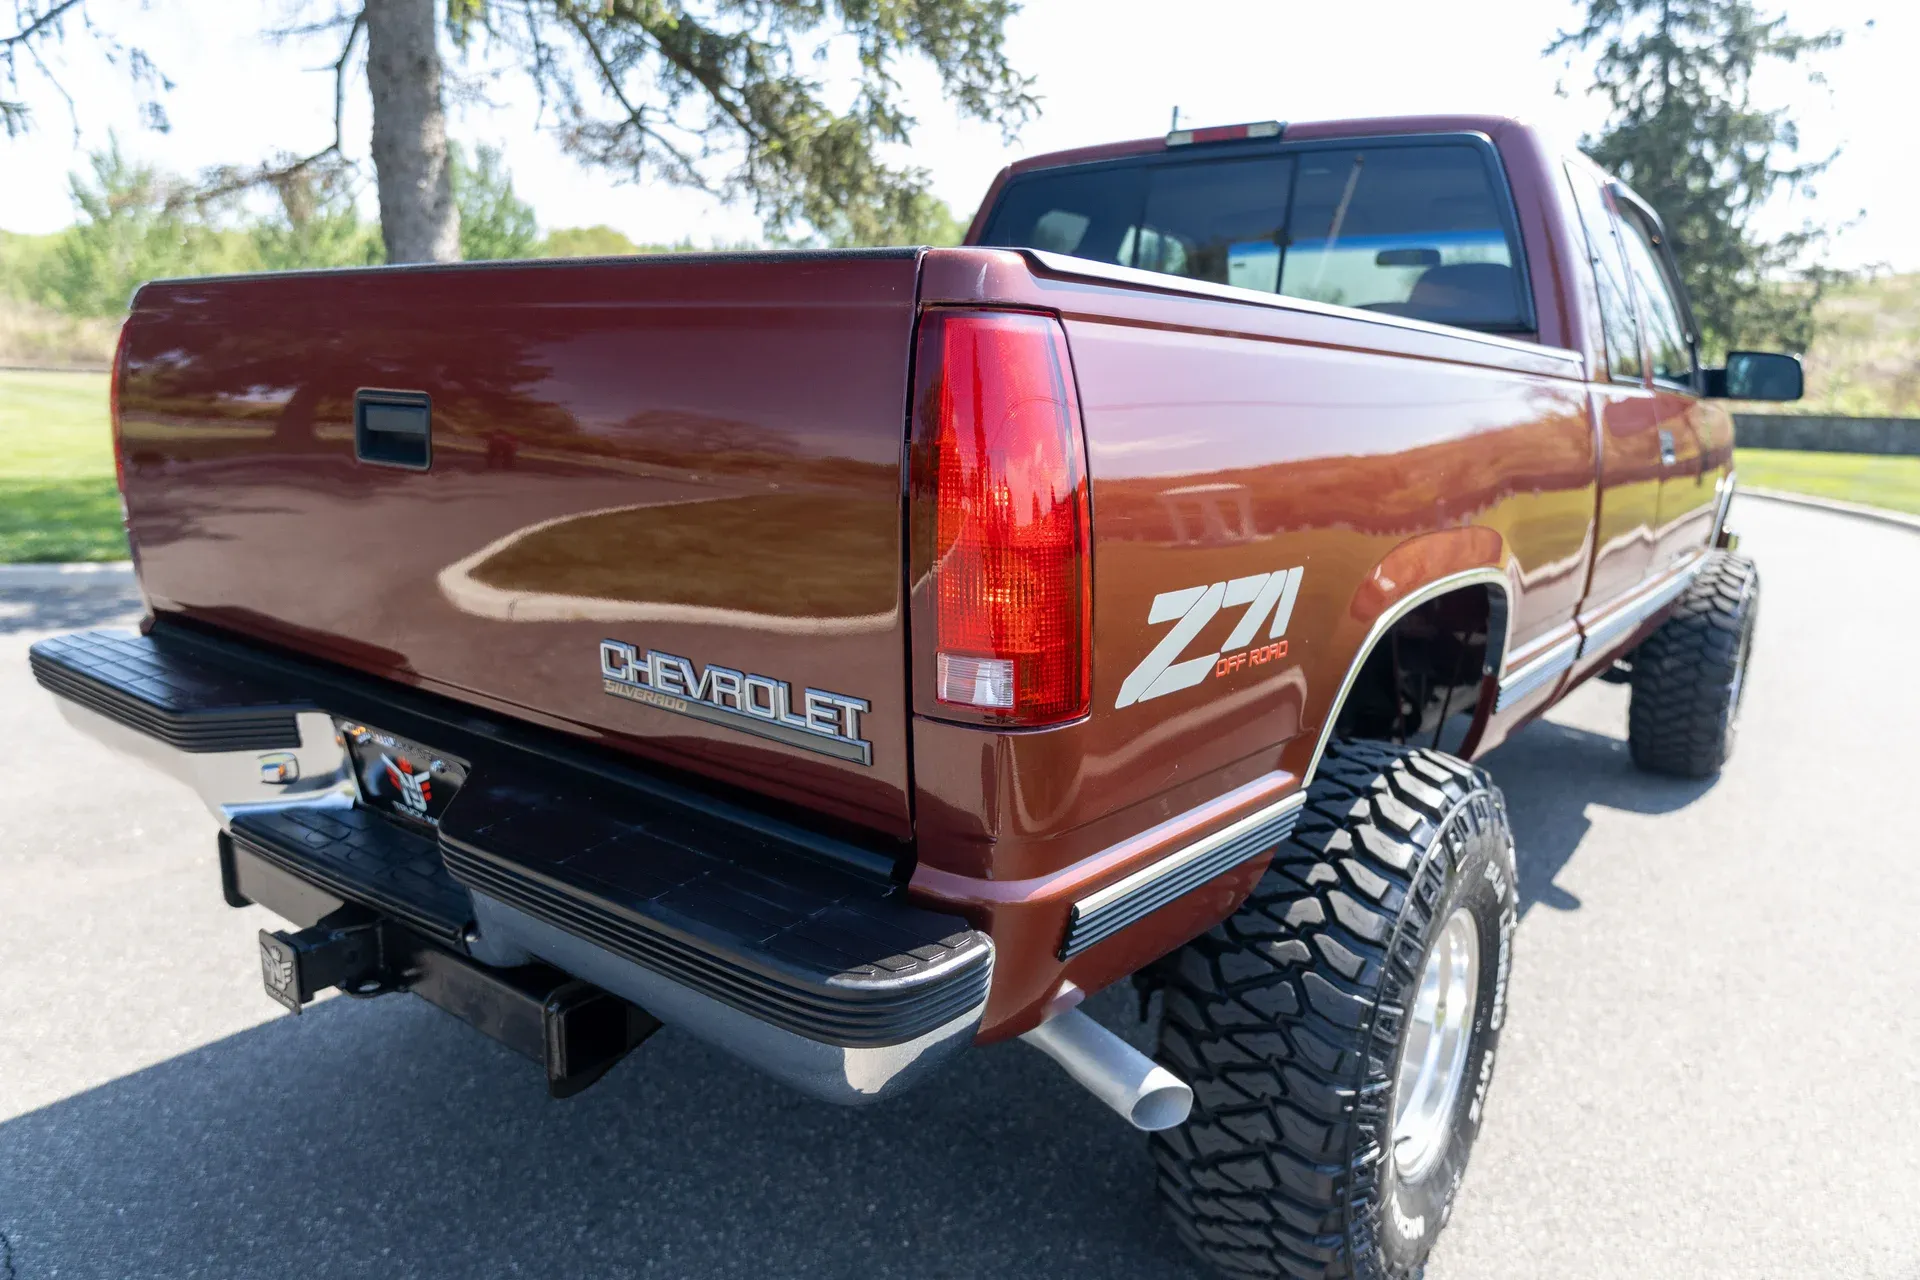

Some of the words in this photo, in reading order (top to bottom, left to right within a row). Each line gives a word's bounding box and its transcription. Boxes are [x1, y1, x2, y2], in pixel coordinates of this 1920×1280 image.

[1115, 566, 1304, 709] Z71
[1215, 652, 1247, 678] OFF
[1248, 640, 1289, 667] ROAD
[600, 638, 871, 740] CHEVROLET
[604, 679, 688, 712] SILVERADO
